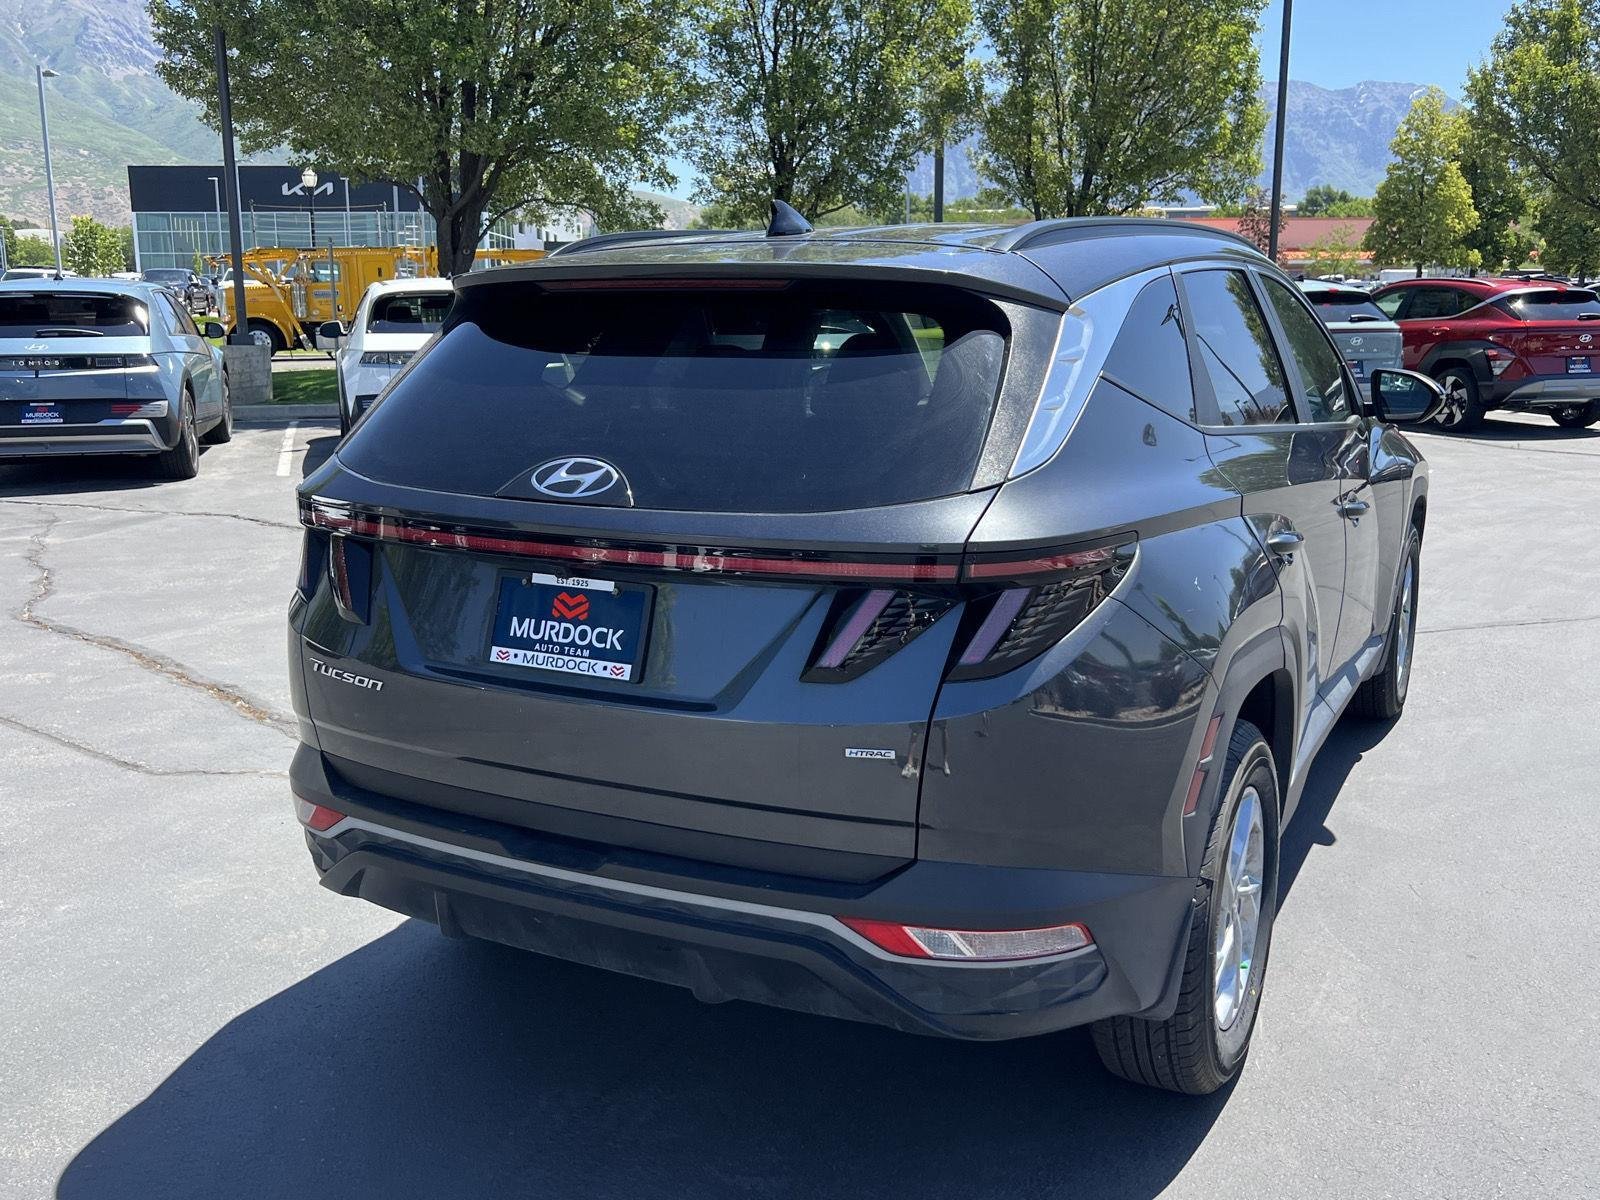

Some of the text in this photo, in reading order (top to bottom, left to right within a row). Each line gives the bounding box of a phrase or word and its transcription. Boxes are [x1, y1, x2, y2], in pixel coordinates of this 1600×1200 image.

[281, 182, 334, 196] KA
[509, 616, 624, 650] MURDOCK
[534, 643, 590, 657] AUTO TEAM
[522, 652, 598, 674] MURDOCK
[848, 750, 892, 758] HTRAC
